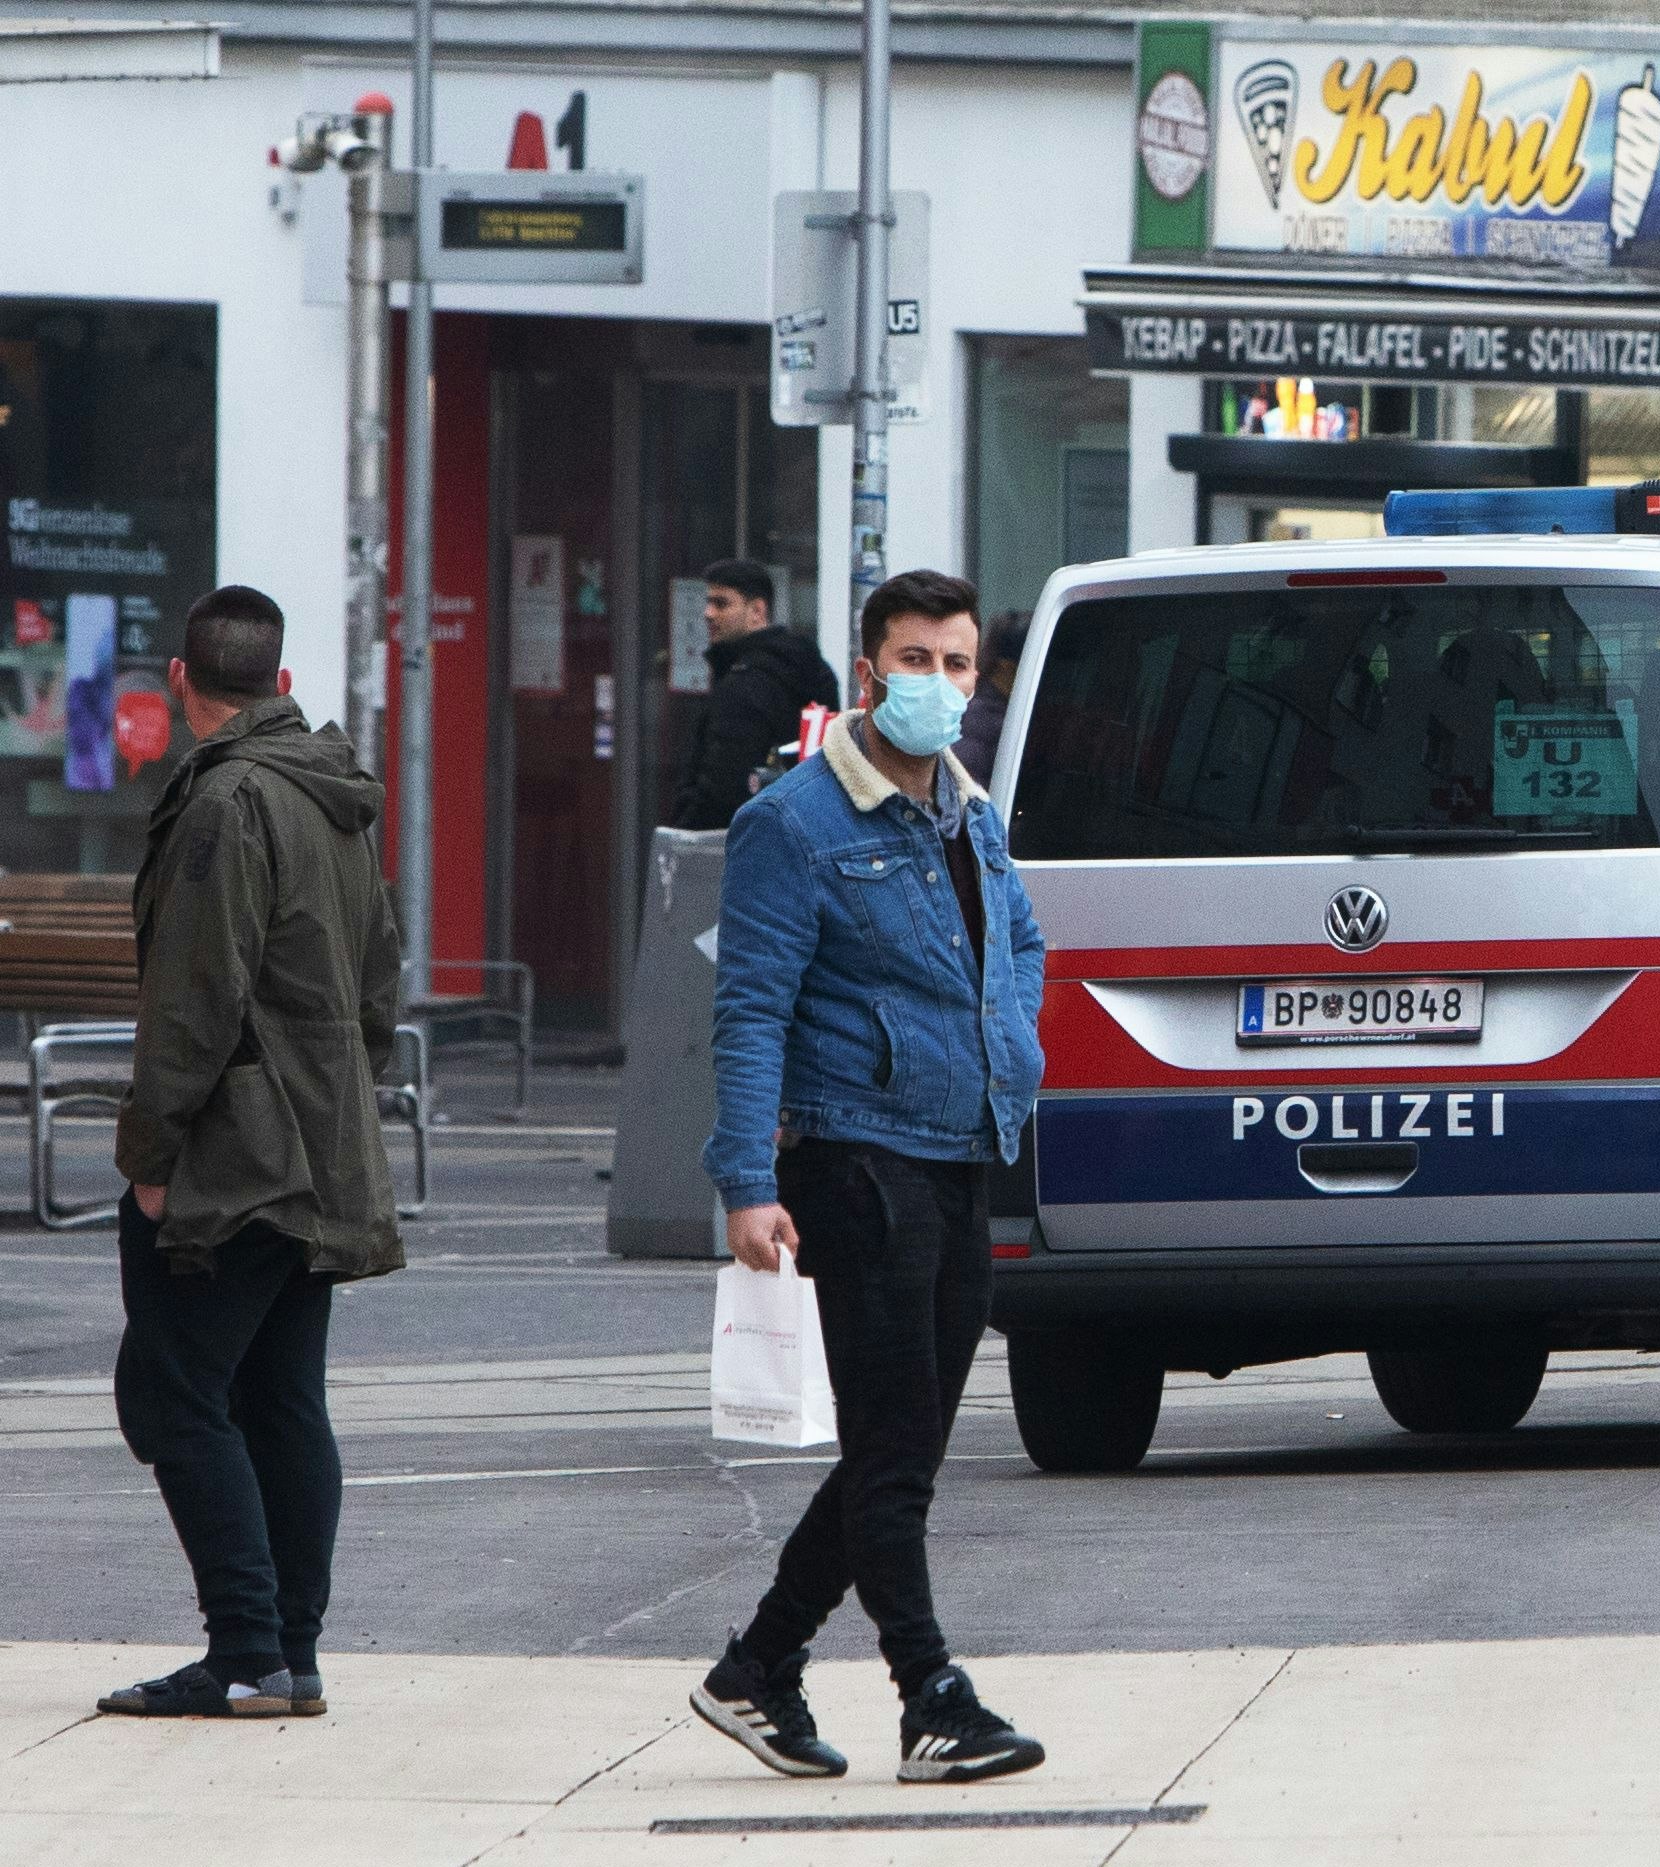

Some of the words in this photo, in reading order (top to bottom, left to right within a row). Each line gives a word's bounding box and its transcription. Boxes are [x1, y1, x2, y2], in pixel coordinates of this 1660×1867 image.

[506, 89, 585, 169] A1
[1293, 55, 1593, 208] Kabul
[888, 302, 919, 332] U5
[1121, 317, 1207, 361] KEBAP
[1227, 319, 1299, 364] PIZZA
[1317, 322, 1428, 369] FALAFEL
[1449, 326, 1509, 371] PIDE
[1543, 741, 1583, 766] U
[1522, 770, 1602, 799] 132
[1247, 1015, 1259, 1027] A
[1275, 991, 1319, 1027] BP
[1348, 987, 1463, 1025] 90848
[1233, 1093, 1505, 1141] POLIZEI
